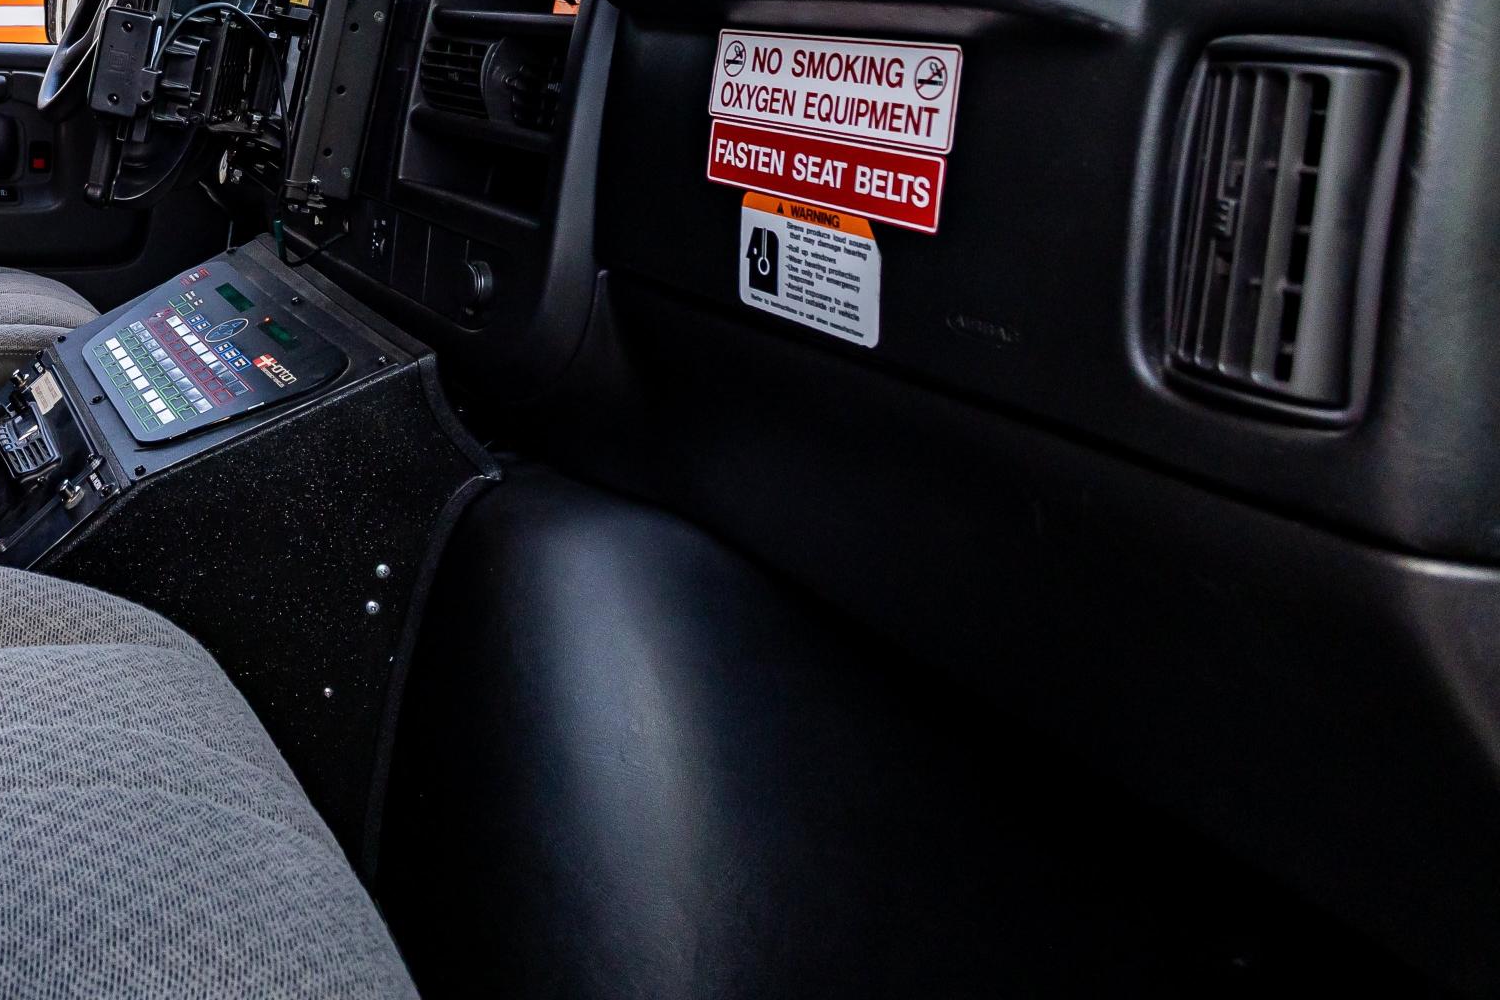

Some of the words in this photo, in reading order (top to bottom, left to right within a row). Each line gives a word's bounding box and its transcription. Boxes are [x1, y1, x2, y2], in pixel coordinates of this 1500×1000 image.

[752, 47, 782, 75] NO
[791, 49, 904, 88] SMOKING
[721, 81, 796, 117] OXYGEN
[803, 92, 940, 137] EQUIPMENT
[715, 138, 785, 176] FASTEN
[792, 152, 848, 189] SEAT
[854, 165, 931, 208] BELTS
[791, 205, 840, 228] WARNING
[790, 232, 800, 240] that
[803, 236, 815, 245] may
[818, 240, 841, 252] damage
[844, 246, 867, 261] hearing
[807, 228, 830, 239] produce
[833, 234, 846, 244] loud
[849, 240, 871, 251] sounds
[811, 252, 836, 264] windows
[805, 260, 826, 273] hearing
[829, 268, 860, 282] protection
[826, 277, 860, 293] emergency
